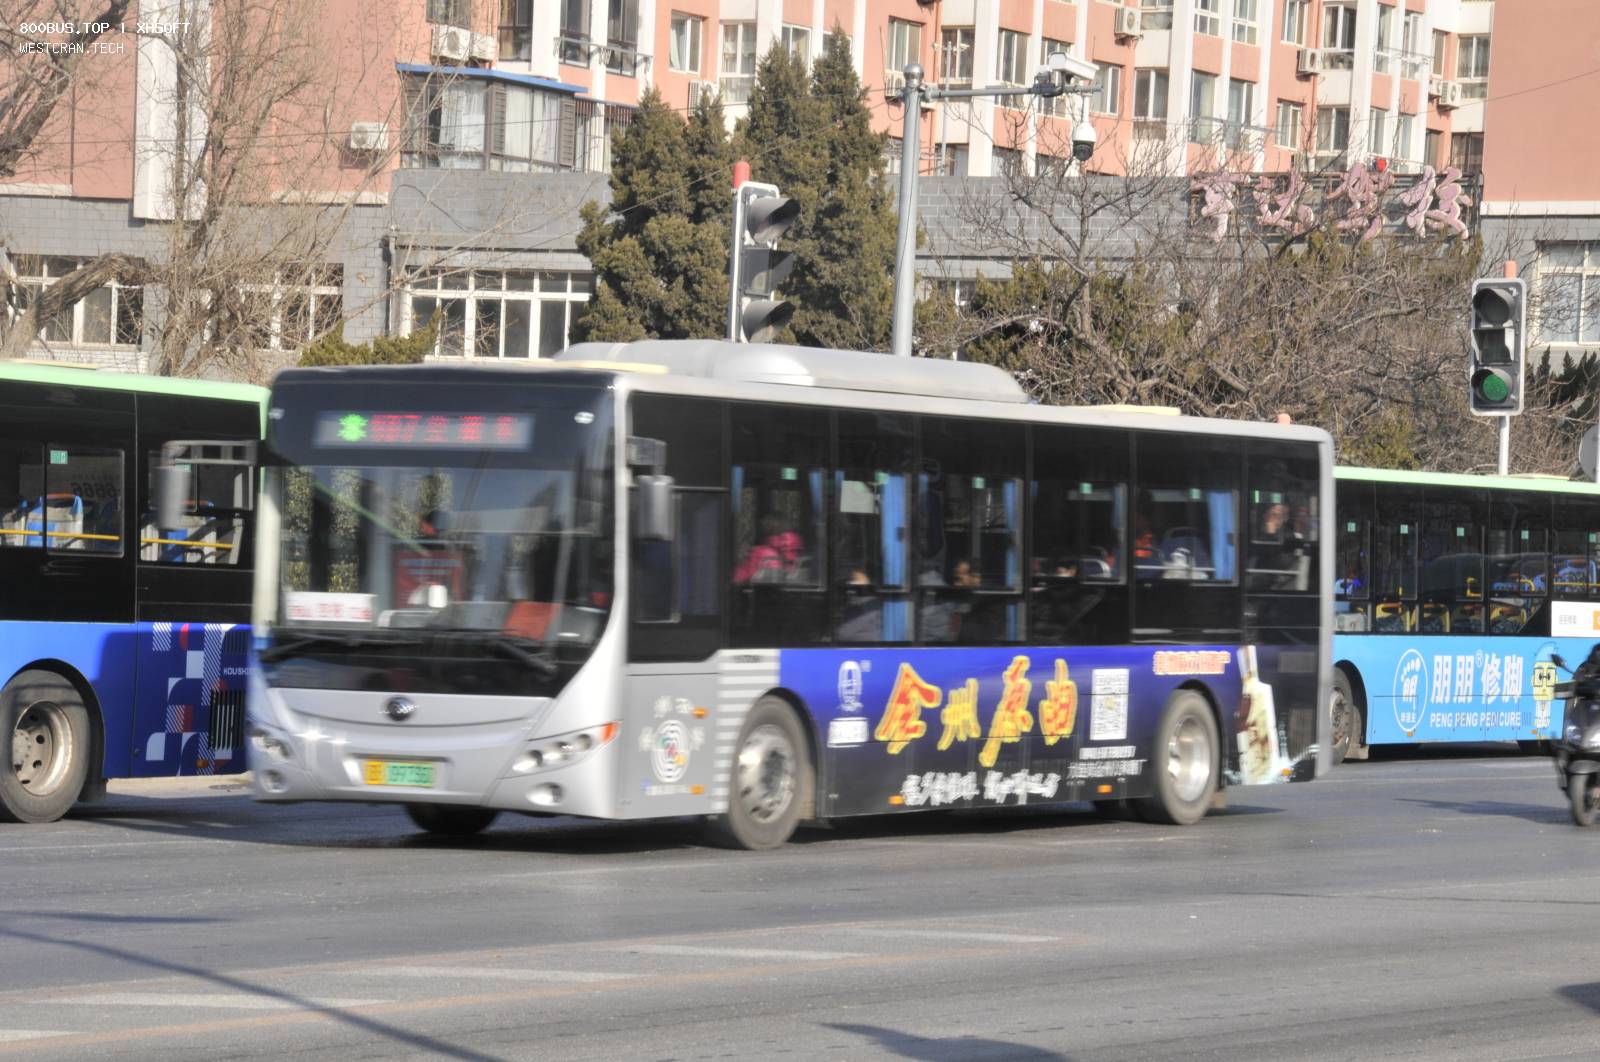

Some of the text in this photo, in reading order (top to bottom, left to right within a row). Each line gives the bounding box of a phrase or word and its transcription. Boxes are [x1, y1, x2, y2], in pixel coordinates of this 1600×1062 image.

[1430, 712, 1453, 728] PENG
[1455, 712, 1478, 728] PENG
[1480, 712, 1521, 728] PEDICURE
